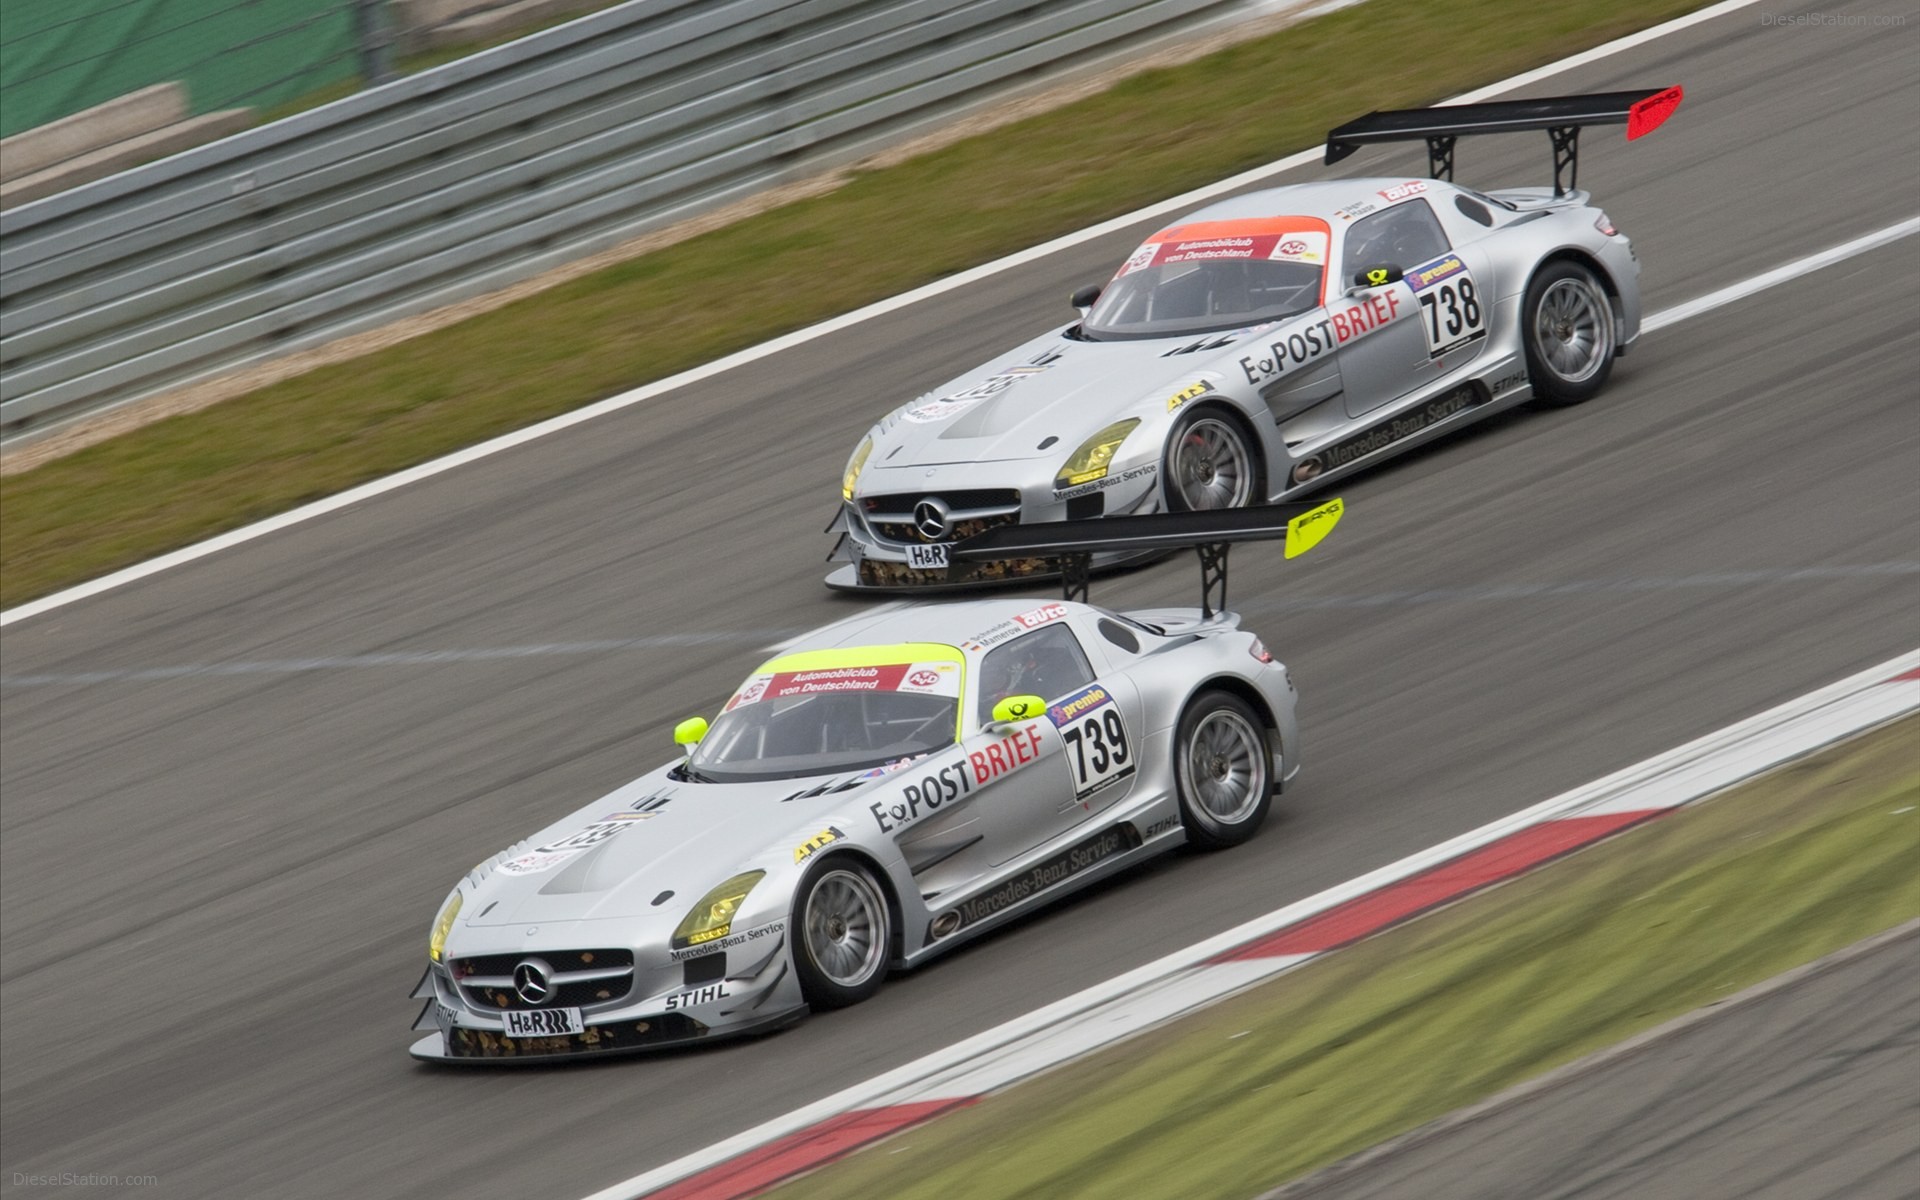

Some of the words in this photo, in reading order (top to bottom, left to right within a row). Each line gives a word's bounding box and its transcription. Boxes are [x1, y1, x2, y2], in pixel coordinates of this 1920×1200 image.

[1386, 182, 1428, 200] auto
[1164, 254, 1183, 263] von
[1184, 248, 1253, 261] Deutschland
[1176, 237, 1253, 251] Automobilclub
[1419, 258, 1461, 285] premio
[1420, 277, 1480, 344] 738
[1492, 370, 1528, 395] STIHL
[1167, 380, 1207, 414] ATS
[1326, 413, 1425, 469] Mercedes-Benz
[1427, 388, 1473, 423] Service
[1052, 475, 1121, 502] Mercedes-Benz
[1122, 464, 1157, 482] Service
[911, 545, 945, 566] H&R
[1023, 606, 1068, 627] auto
[979, 626, 1022, 647] Mamerow
[779, 687, 799, 696] von
[801, 680, 879, 693] Deutschland
[790, 668, 878, 684] Automobilclub
[1062, 689, 1106, 719] premio
[1063, 709, 1128, 784] 739
[1145, 813, 1180, 839] STIHL
[793, 829, 837, 865] ATS
[963, 859, 1067, 925] Mercedes-Benz
[1070, 832, 1119, 871] Service
[670, 935, 746, 963] Mercedes-Benz
[747, 922, 785, 941] Service
[665, 984, 730, 1011] STIHL
[436, 1005, 458, 1025] STIHL
[508, 1009, 545, 1034] H&R
